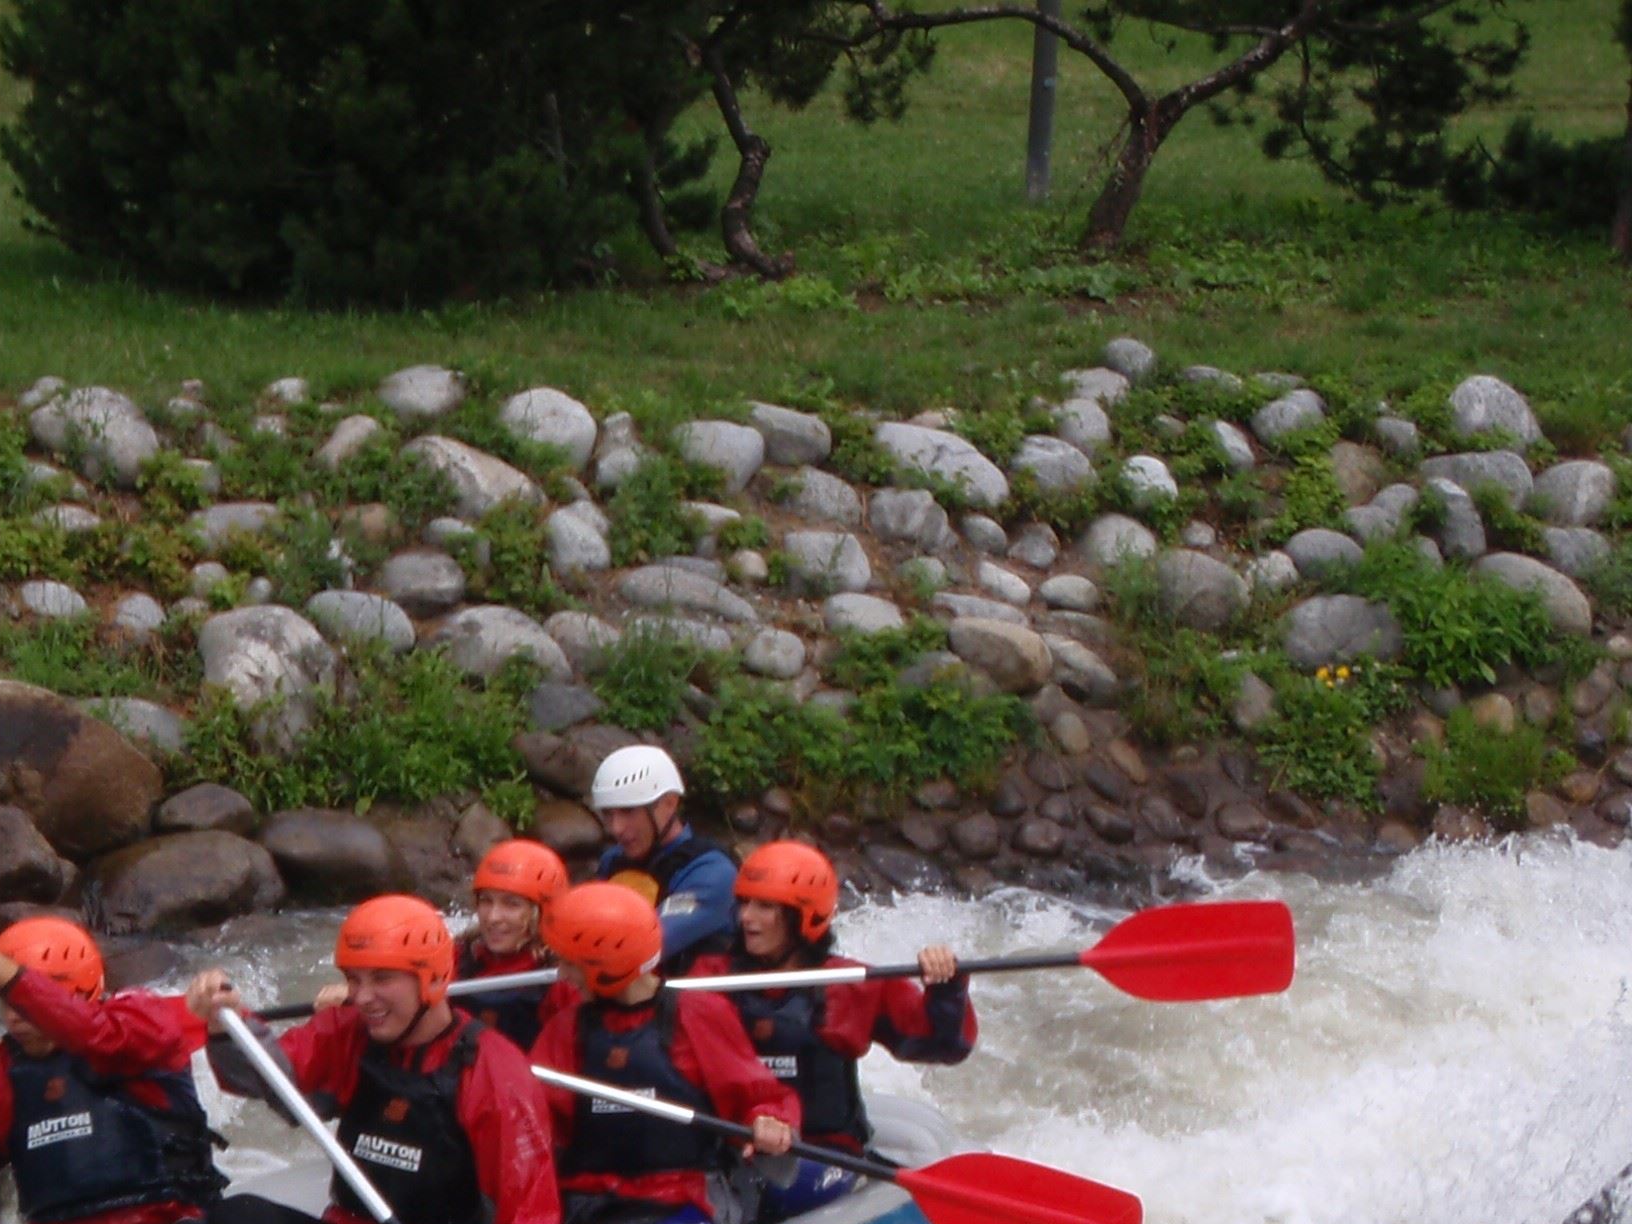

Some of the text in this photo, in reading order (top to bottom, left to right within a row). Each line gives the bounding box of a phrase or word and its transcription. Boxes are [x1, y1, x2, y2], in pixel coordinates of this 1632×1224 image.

[757, 1055, 796, 1069] TTON
[28, 1111, 90, 1140] MUTTON
[355, 1133, 422, 1162] MUTTON
